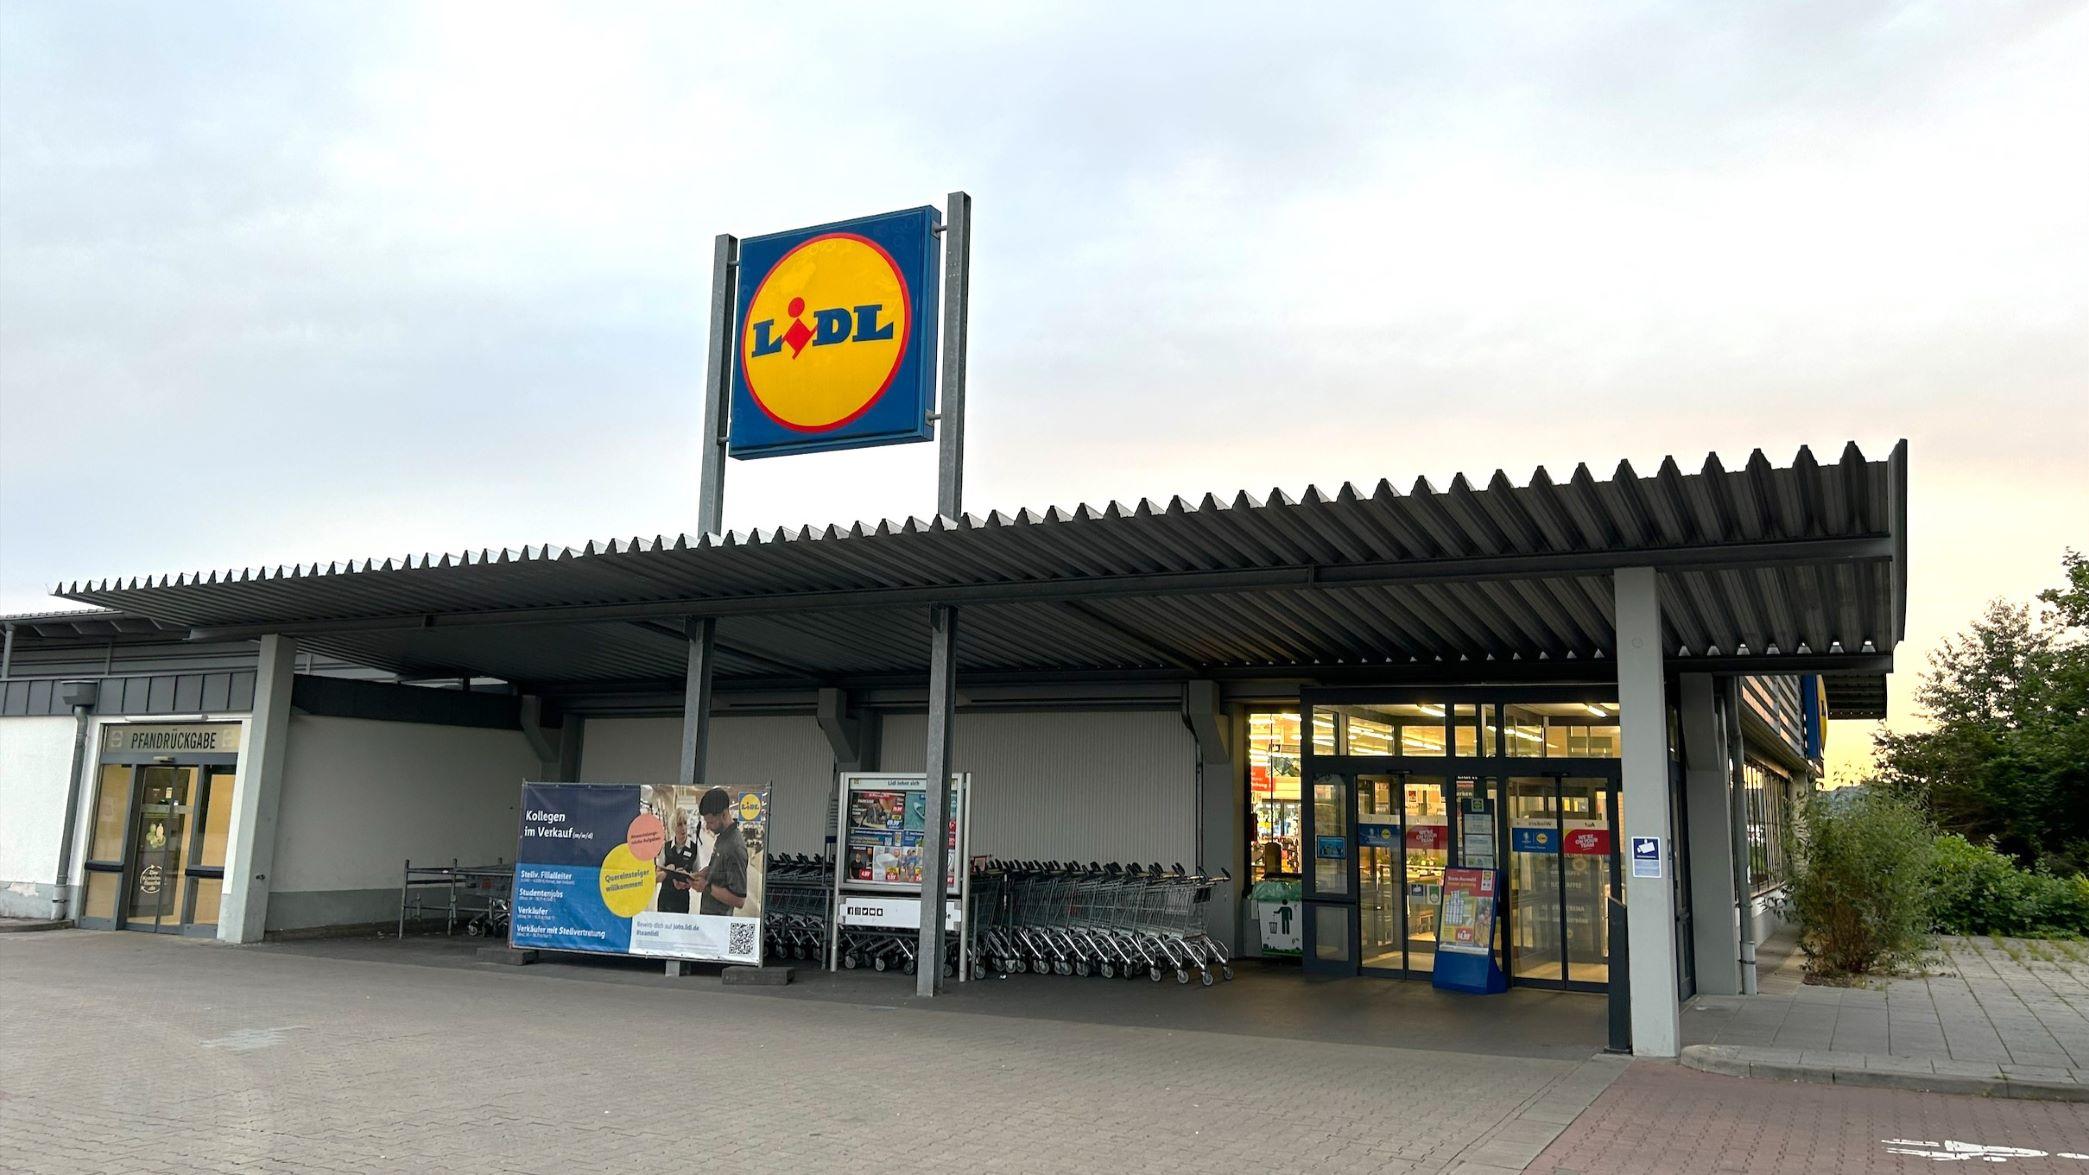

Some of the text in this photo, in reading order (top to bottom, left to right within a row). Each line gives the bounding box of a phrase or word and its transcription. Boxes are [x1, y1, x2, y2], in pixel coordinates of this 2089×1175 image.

[131, 728, 217, 749] PFANDRÜCKGABE
[526, 810, 566, 824] Kollegen
[524, 826, 536, 837] im
[537, 827, 573, 838] Verkauf
[605, 869, 649, 884] Quereinsteiger
[606, 880, 644, 892] willkommen!
[519, 888, 563, 899] Studentenjobs
[517, 906, 549, 915] Verkäufer
[517, 925, 546, 934] Verkäufer
[558, 927, 605, 939] Stellvertretung
